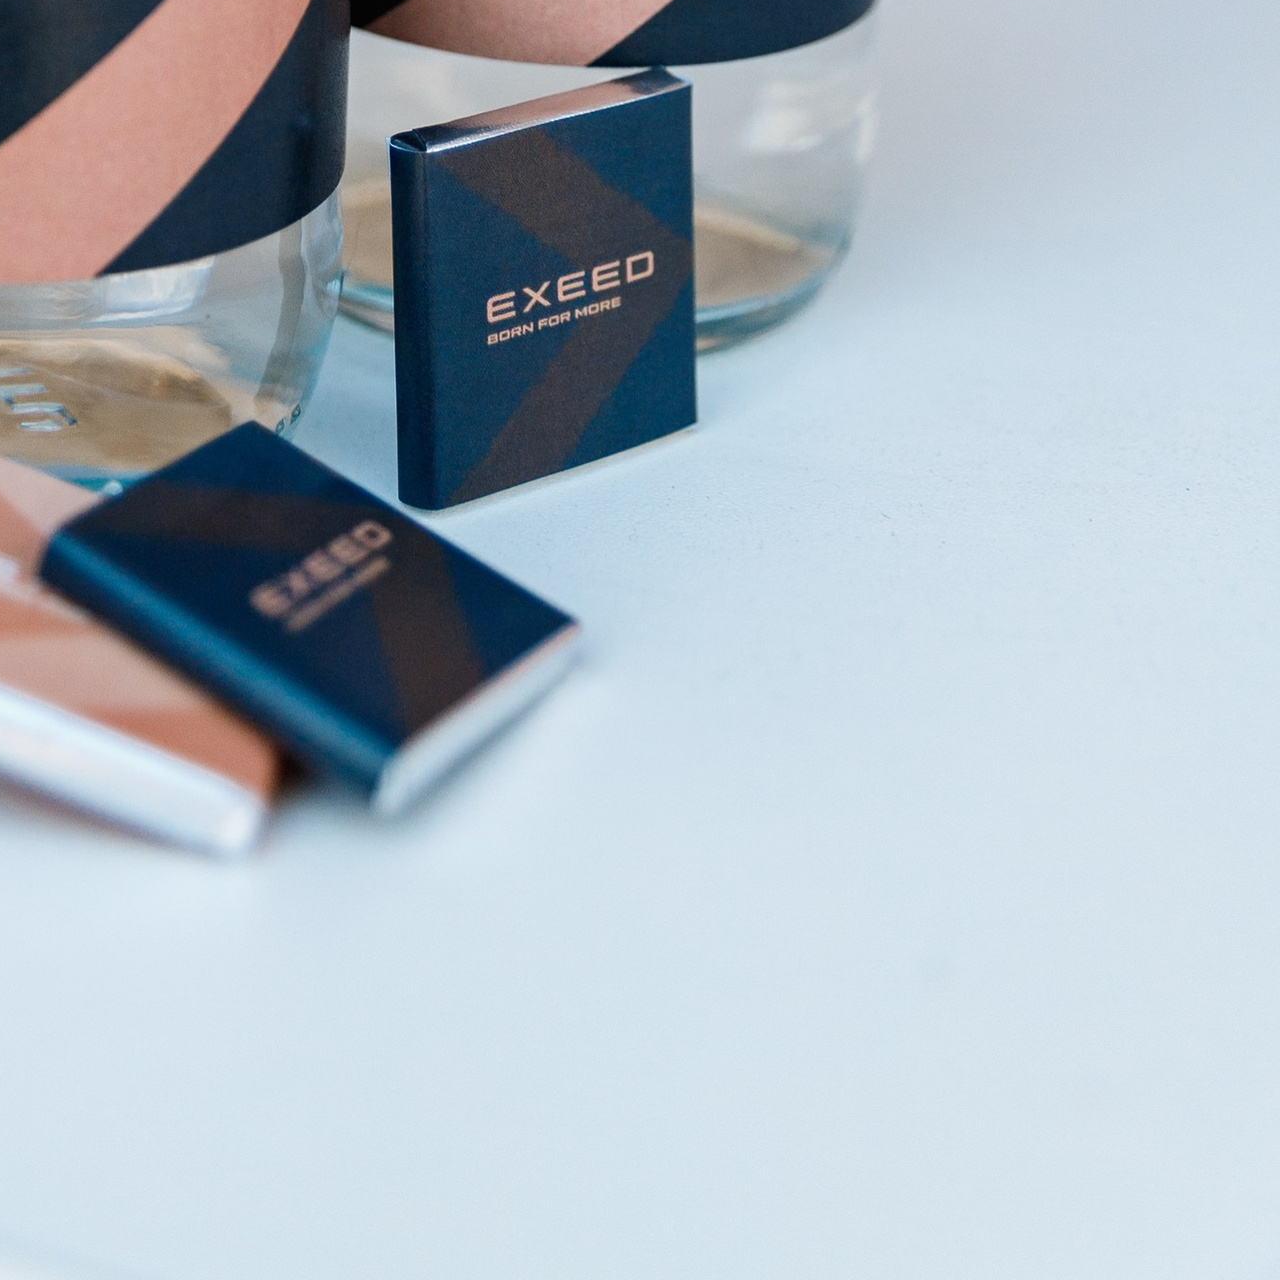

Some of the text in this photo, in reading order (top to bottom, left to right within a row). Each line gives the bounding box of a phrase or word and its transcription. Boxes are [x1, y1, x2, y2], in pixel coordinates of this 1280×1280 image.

[486, 250, 655, 324] EXEED
[487, 296, 622, 346] BORN FOR MORE
